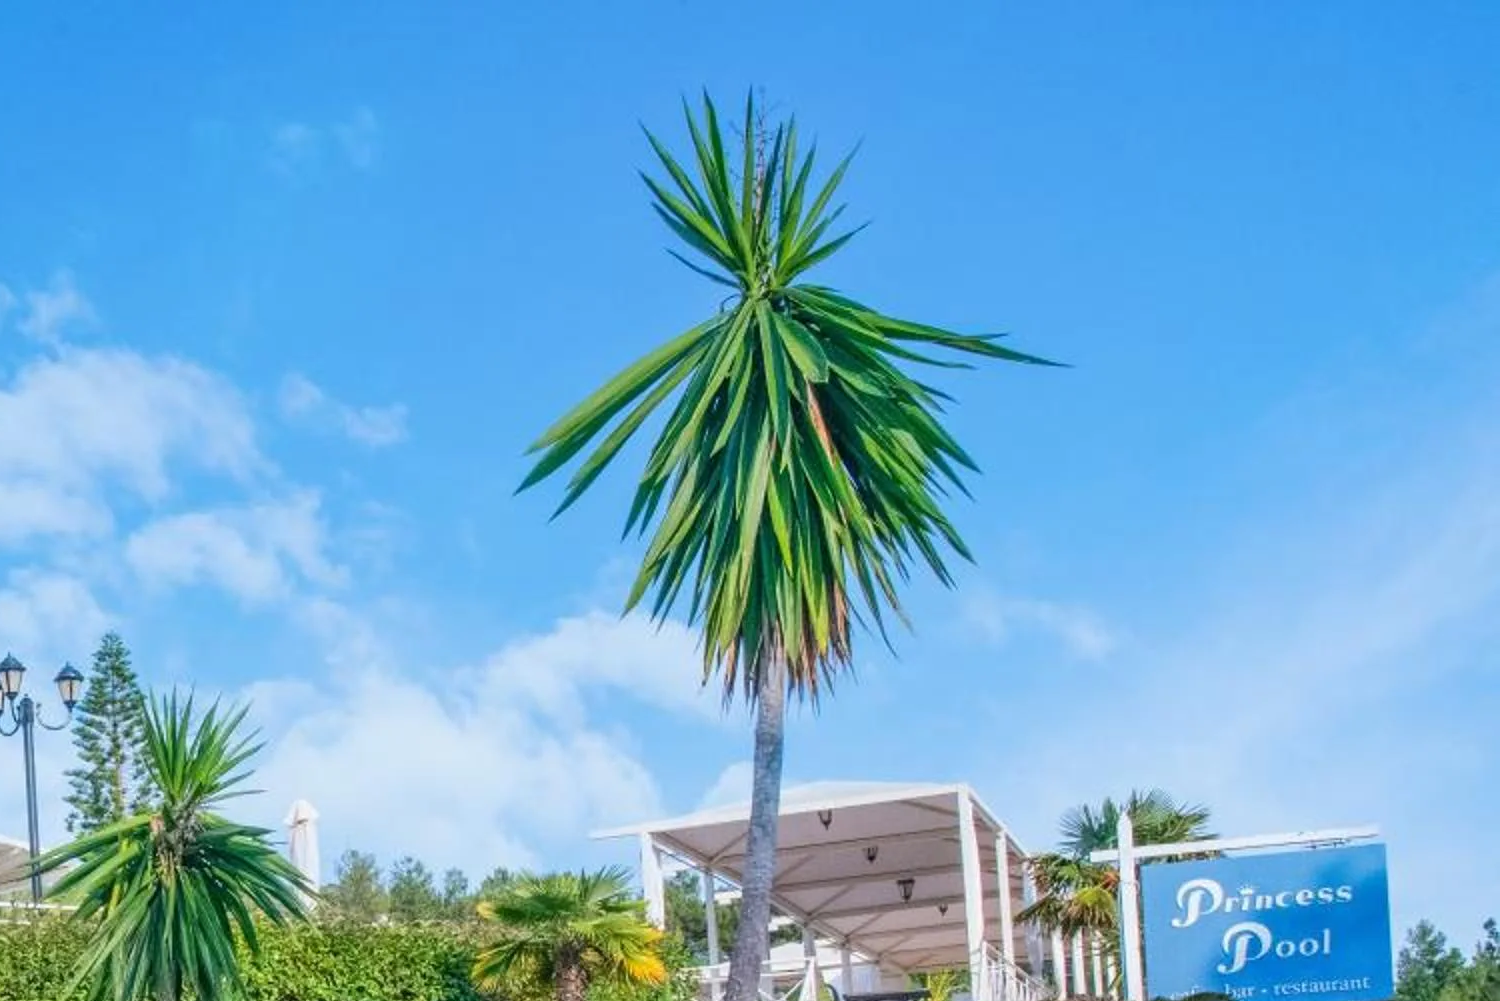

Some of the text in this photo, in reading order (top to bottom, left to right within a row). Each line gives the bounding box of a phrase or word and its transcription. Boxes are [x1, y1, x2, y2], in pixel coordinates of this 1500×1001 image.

[1171, 878, 1353, 928] Princess
[1217, 921, 1331, 974] Pool
[1224, 983, 1255, 998] bar
[1274, 977, 1371, 996] restaurant
